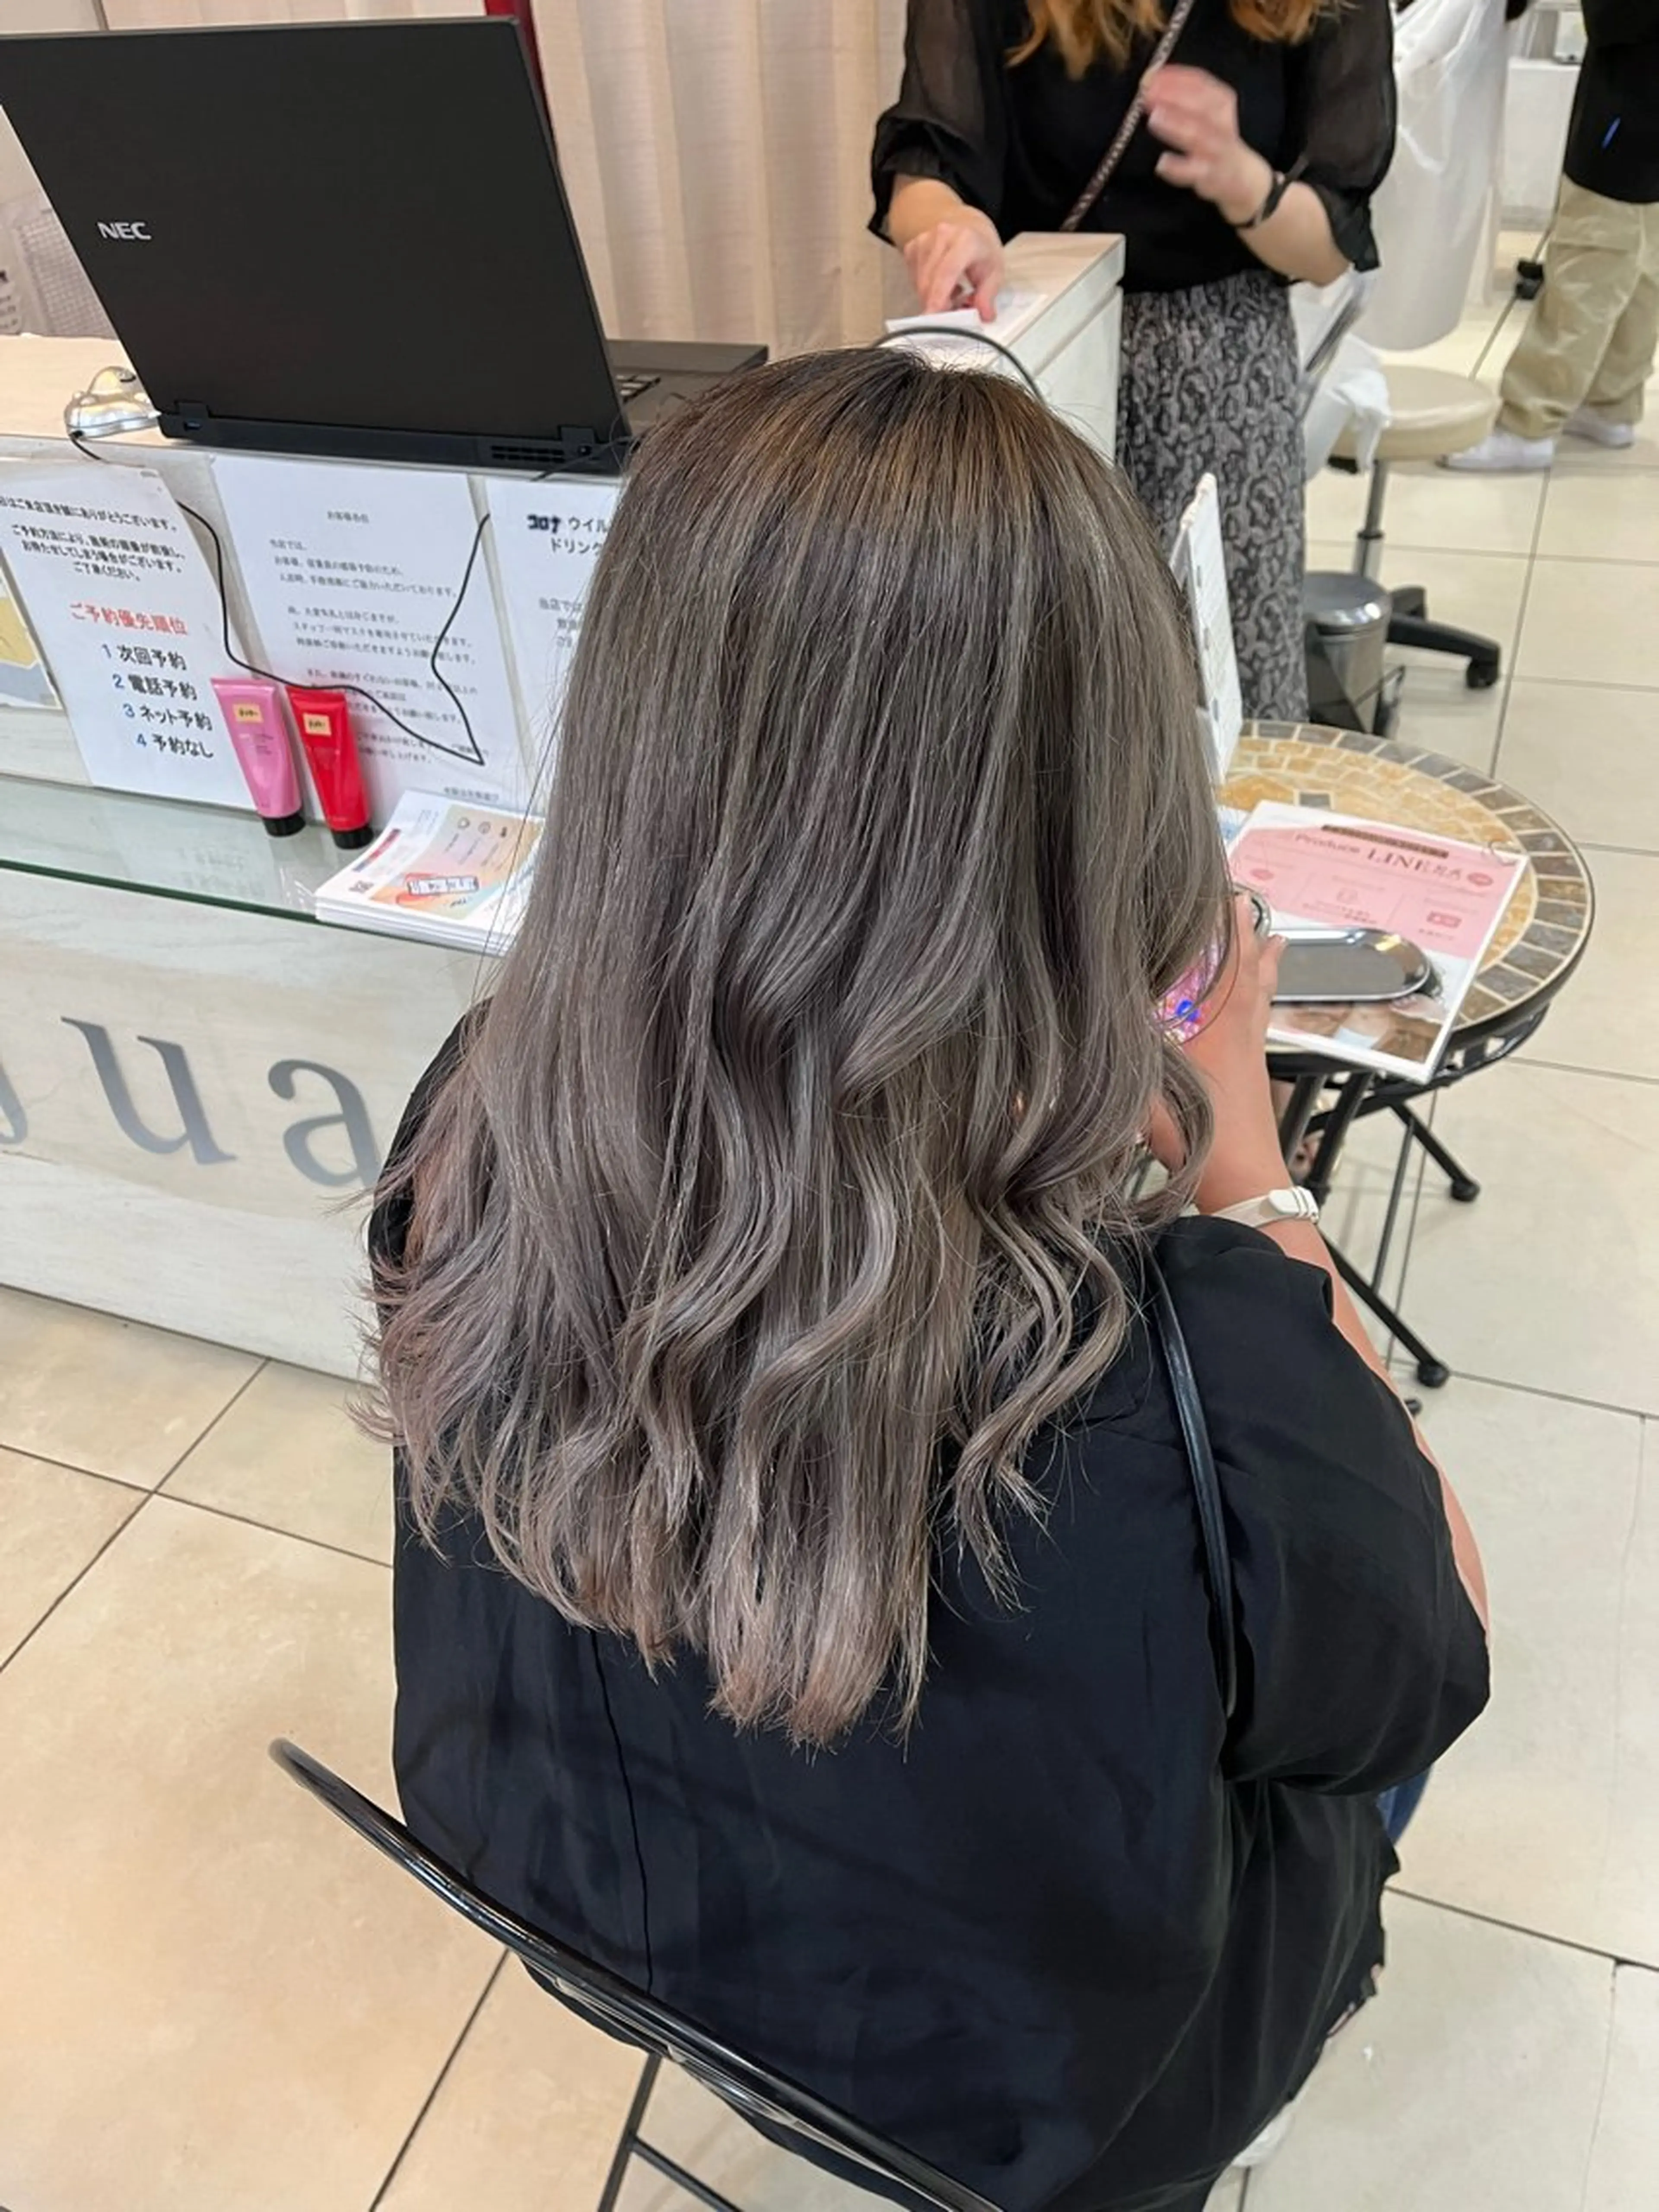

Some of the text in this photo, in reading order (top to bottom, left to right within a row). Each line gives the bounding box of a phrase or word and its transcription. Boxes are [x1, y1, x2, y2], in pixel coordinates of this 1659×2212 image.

[98, 222, 152, 240] NEC
[527, 514, 561, 533] コロナ
[70, 602, 188, 635] ご予約優先順位
[102, 644, 187, 671] 1 次回予約
[112, 674, 197, 701] 2 電話予約
[123, 703, 212, 731] 3 ネット予約
[137, 733, 214, 758] 4 予約なし
